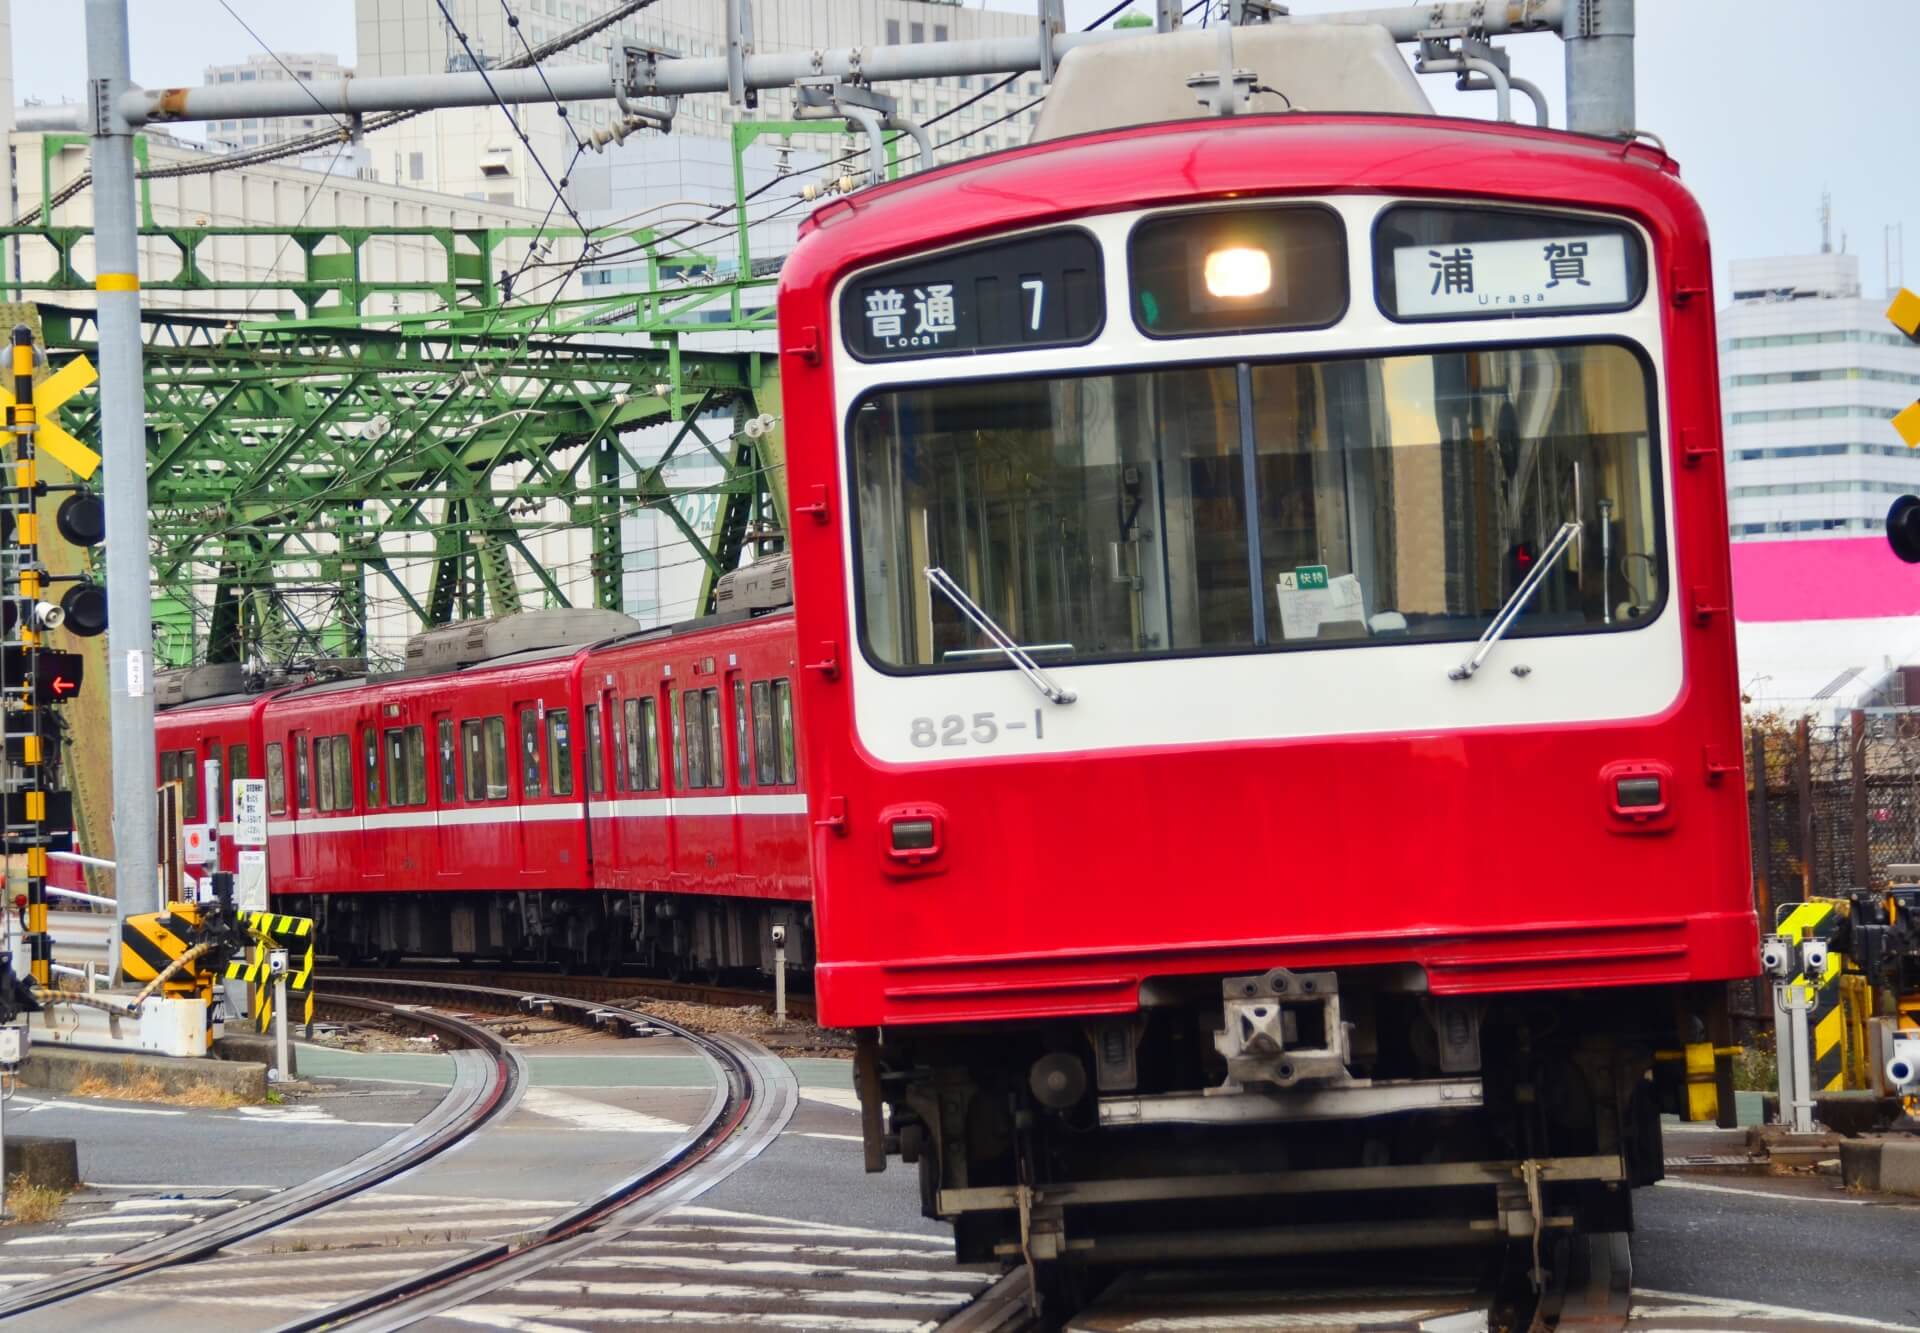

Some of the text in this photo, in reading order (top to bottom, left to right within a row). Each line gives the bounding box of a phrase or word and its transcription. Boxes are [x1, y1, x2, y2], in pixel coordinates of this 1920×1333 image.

[1428, 242, 1591, 296] 浦賀
[865, 284, 956, 337] 普通
[1021, 280, 1044, 331] 7
[1478, 292, 1545, 305] Uraga
[885, 333, 939, 348] Local
[1284, 575, 1294, 588] 4
[1300, 571, 1323, 585] 快特
[910, 708, 1044, 748] 825-1
